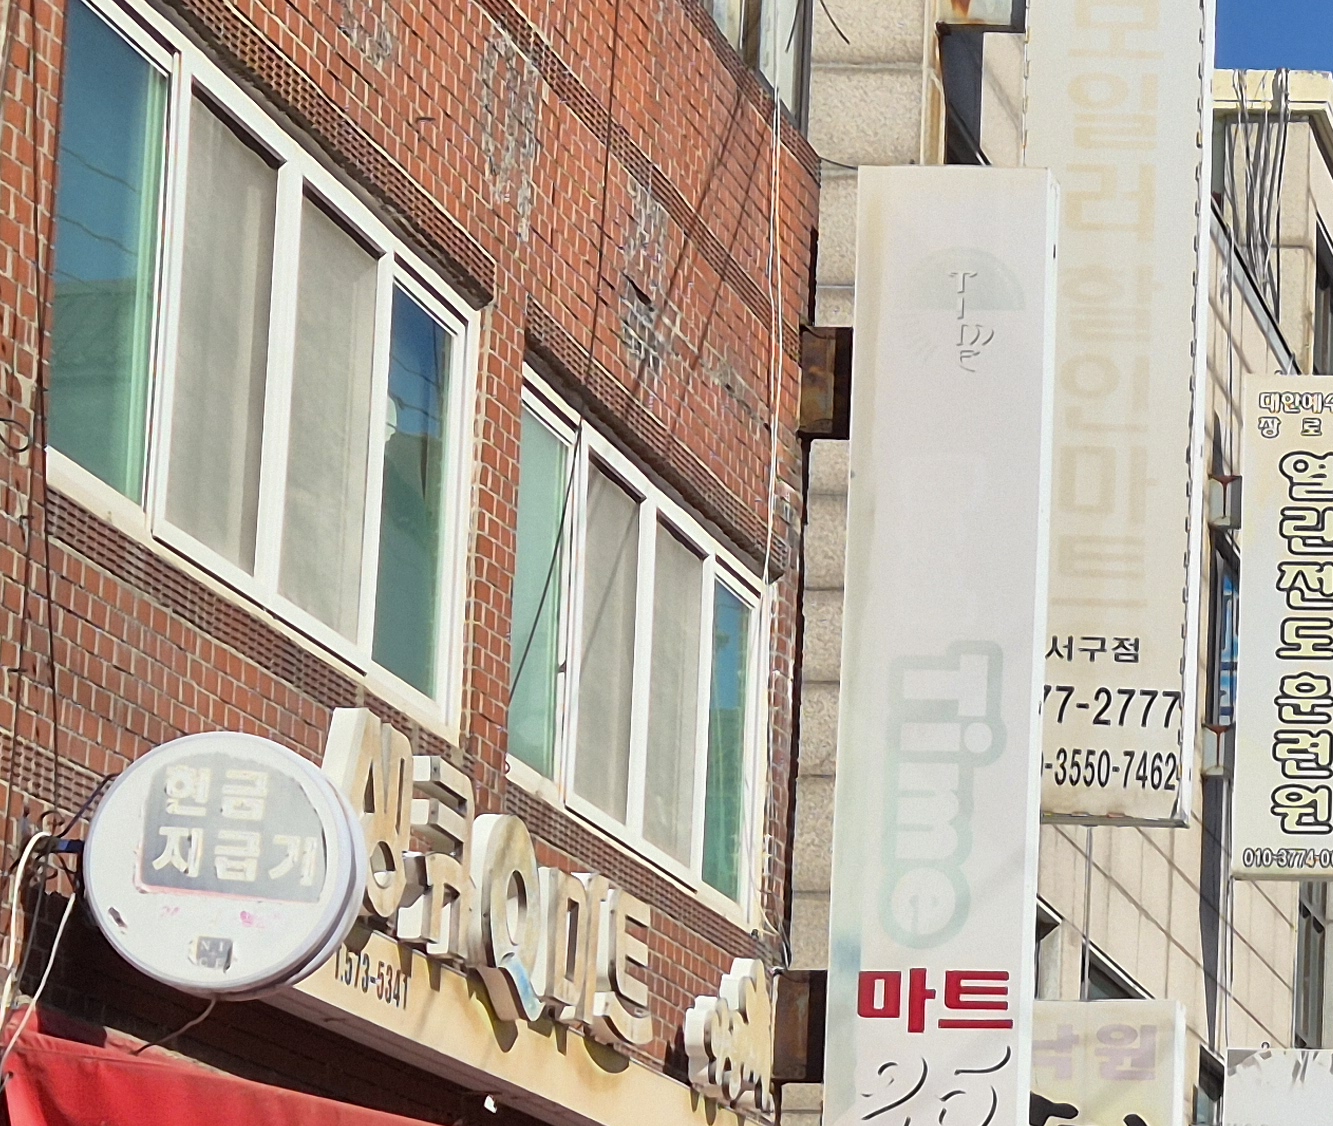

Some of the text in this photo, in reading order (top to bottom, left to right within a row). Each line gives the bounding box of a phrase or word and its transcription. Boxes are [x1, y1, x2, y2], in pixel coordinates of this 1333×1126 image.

[1045, 635, 1140, 663] 서구점
[165, 765, 269, 821] 현금
[1041, 748, 1178, 791] -3550-7462
[152, 826, 317, 886] 지급기
[857, 968, 1013, 1033] 마트
